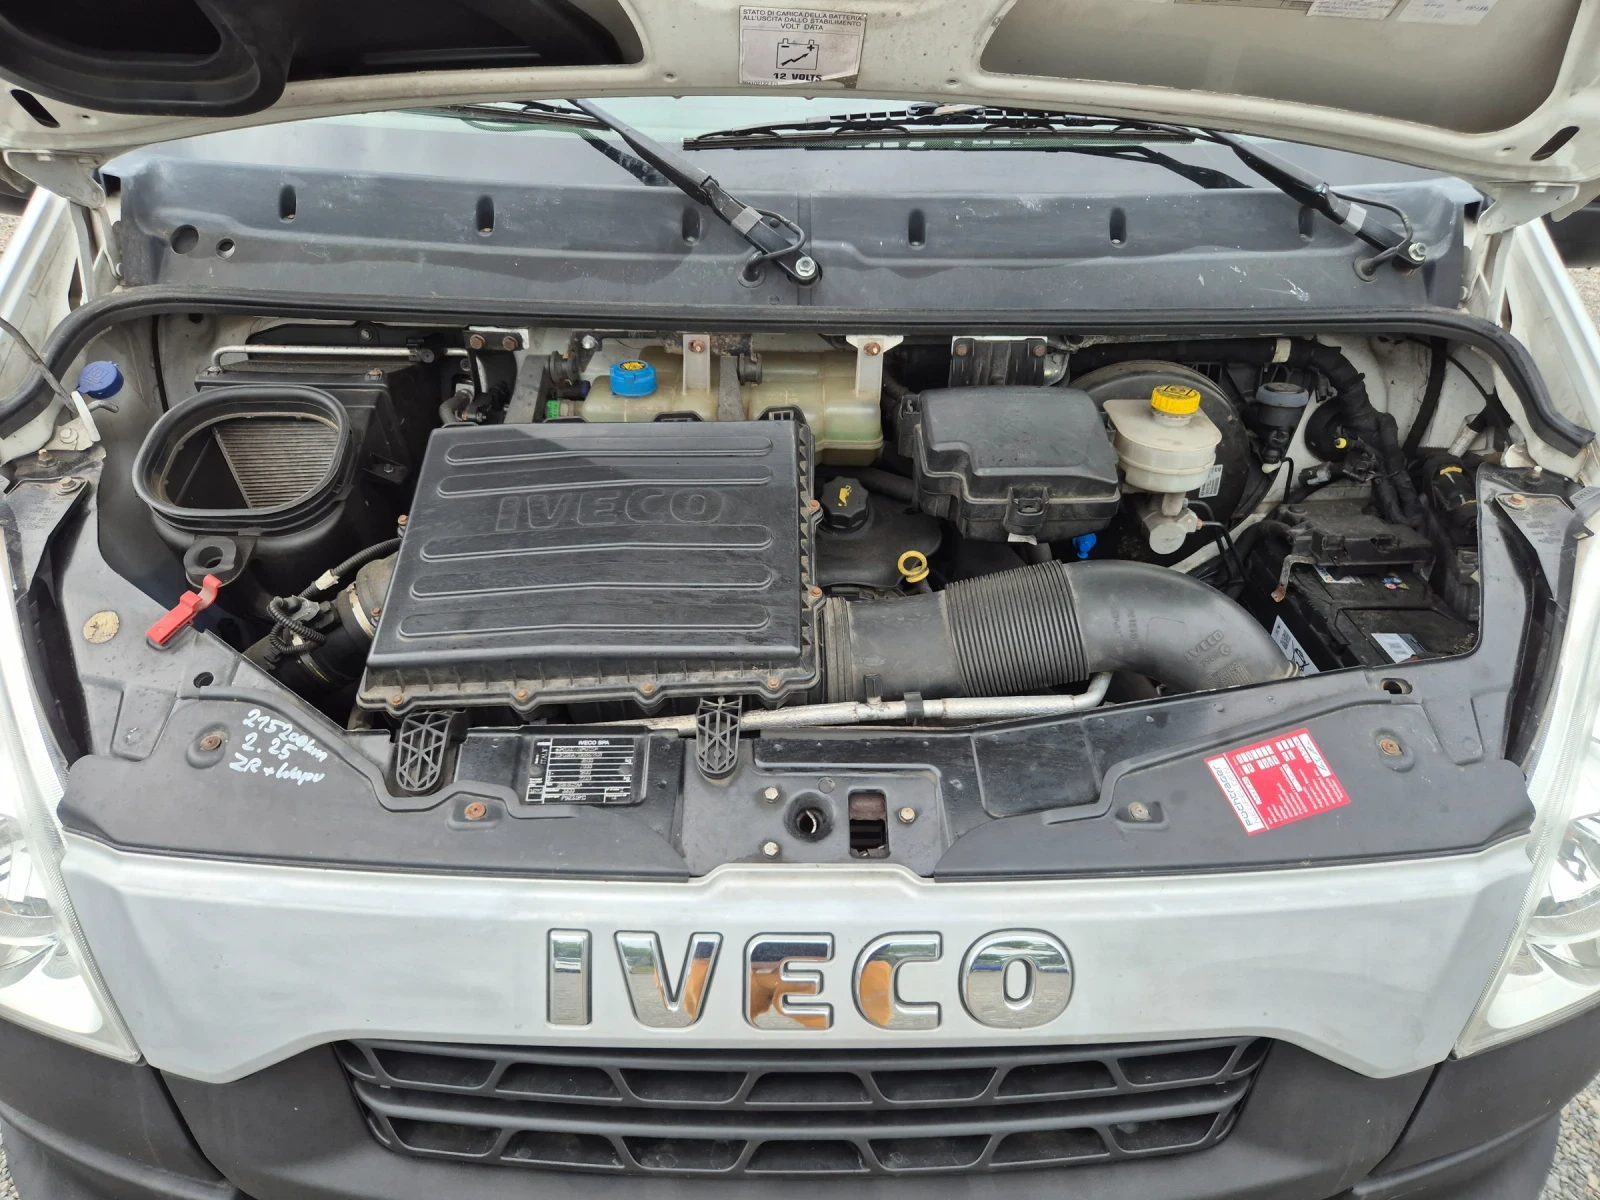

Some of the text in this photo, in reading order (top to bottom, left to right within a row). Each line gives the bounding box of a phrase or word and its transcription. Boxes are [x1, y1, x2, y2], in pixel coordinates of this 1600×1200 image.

[810, 18, 861, 27] STABILIMENTO
[791, 73, 822, 82] VOLTS
[495, 488, 726, 532] IVECO
[1184, 629, 1225, 663] IVECO
[545, 927, 1076, 1031] IVECO
